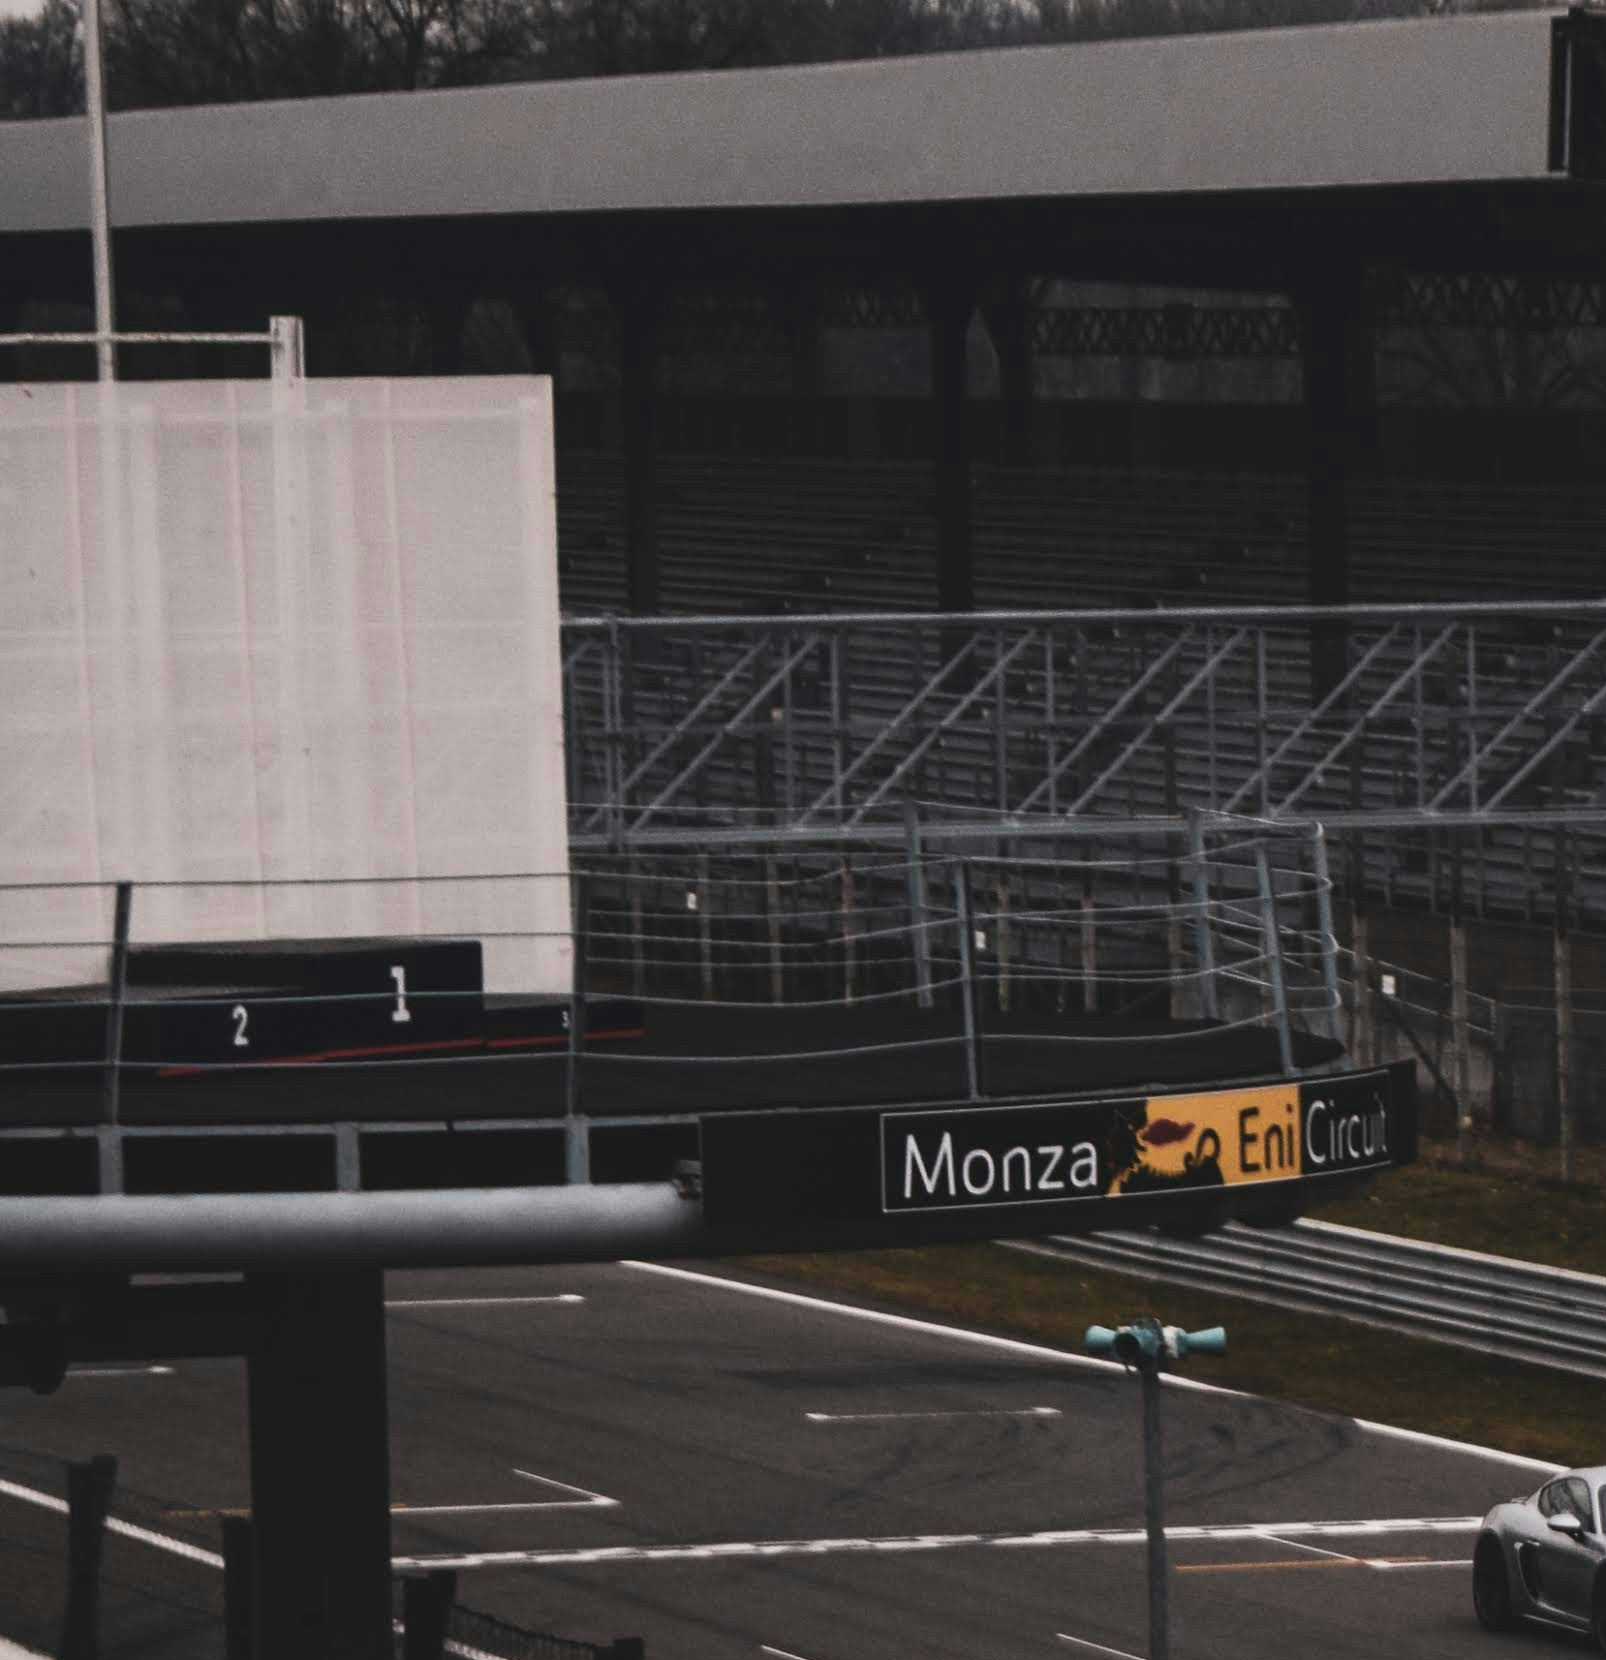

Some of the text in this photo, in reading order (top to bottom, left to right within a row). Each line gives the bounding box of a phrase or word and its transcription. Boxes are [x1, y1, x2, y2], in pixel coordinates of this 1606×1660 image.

[390, 965, 411, 1022] 1
[232, 1004, 249, 1046] 2
[904, 1130, 1098, 1199] Monza
[1239, 1102, 1295, 1174] Eni
